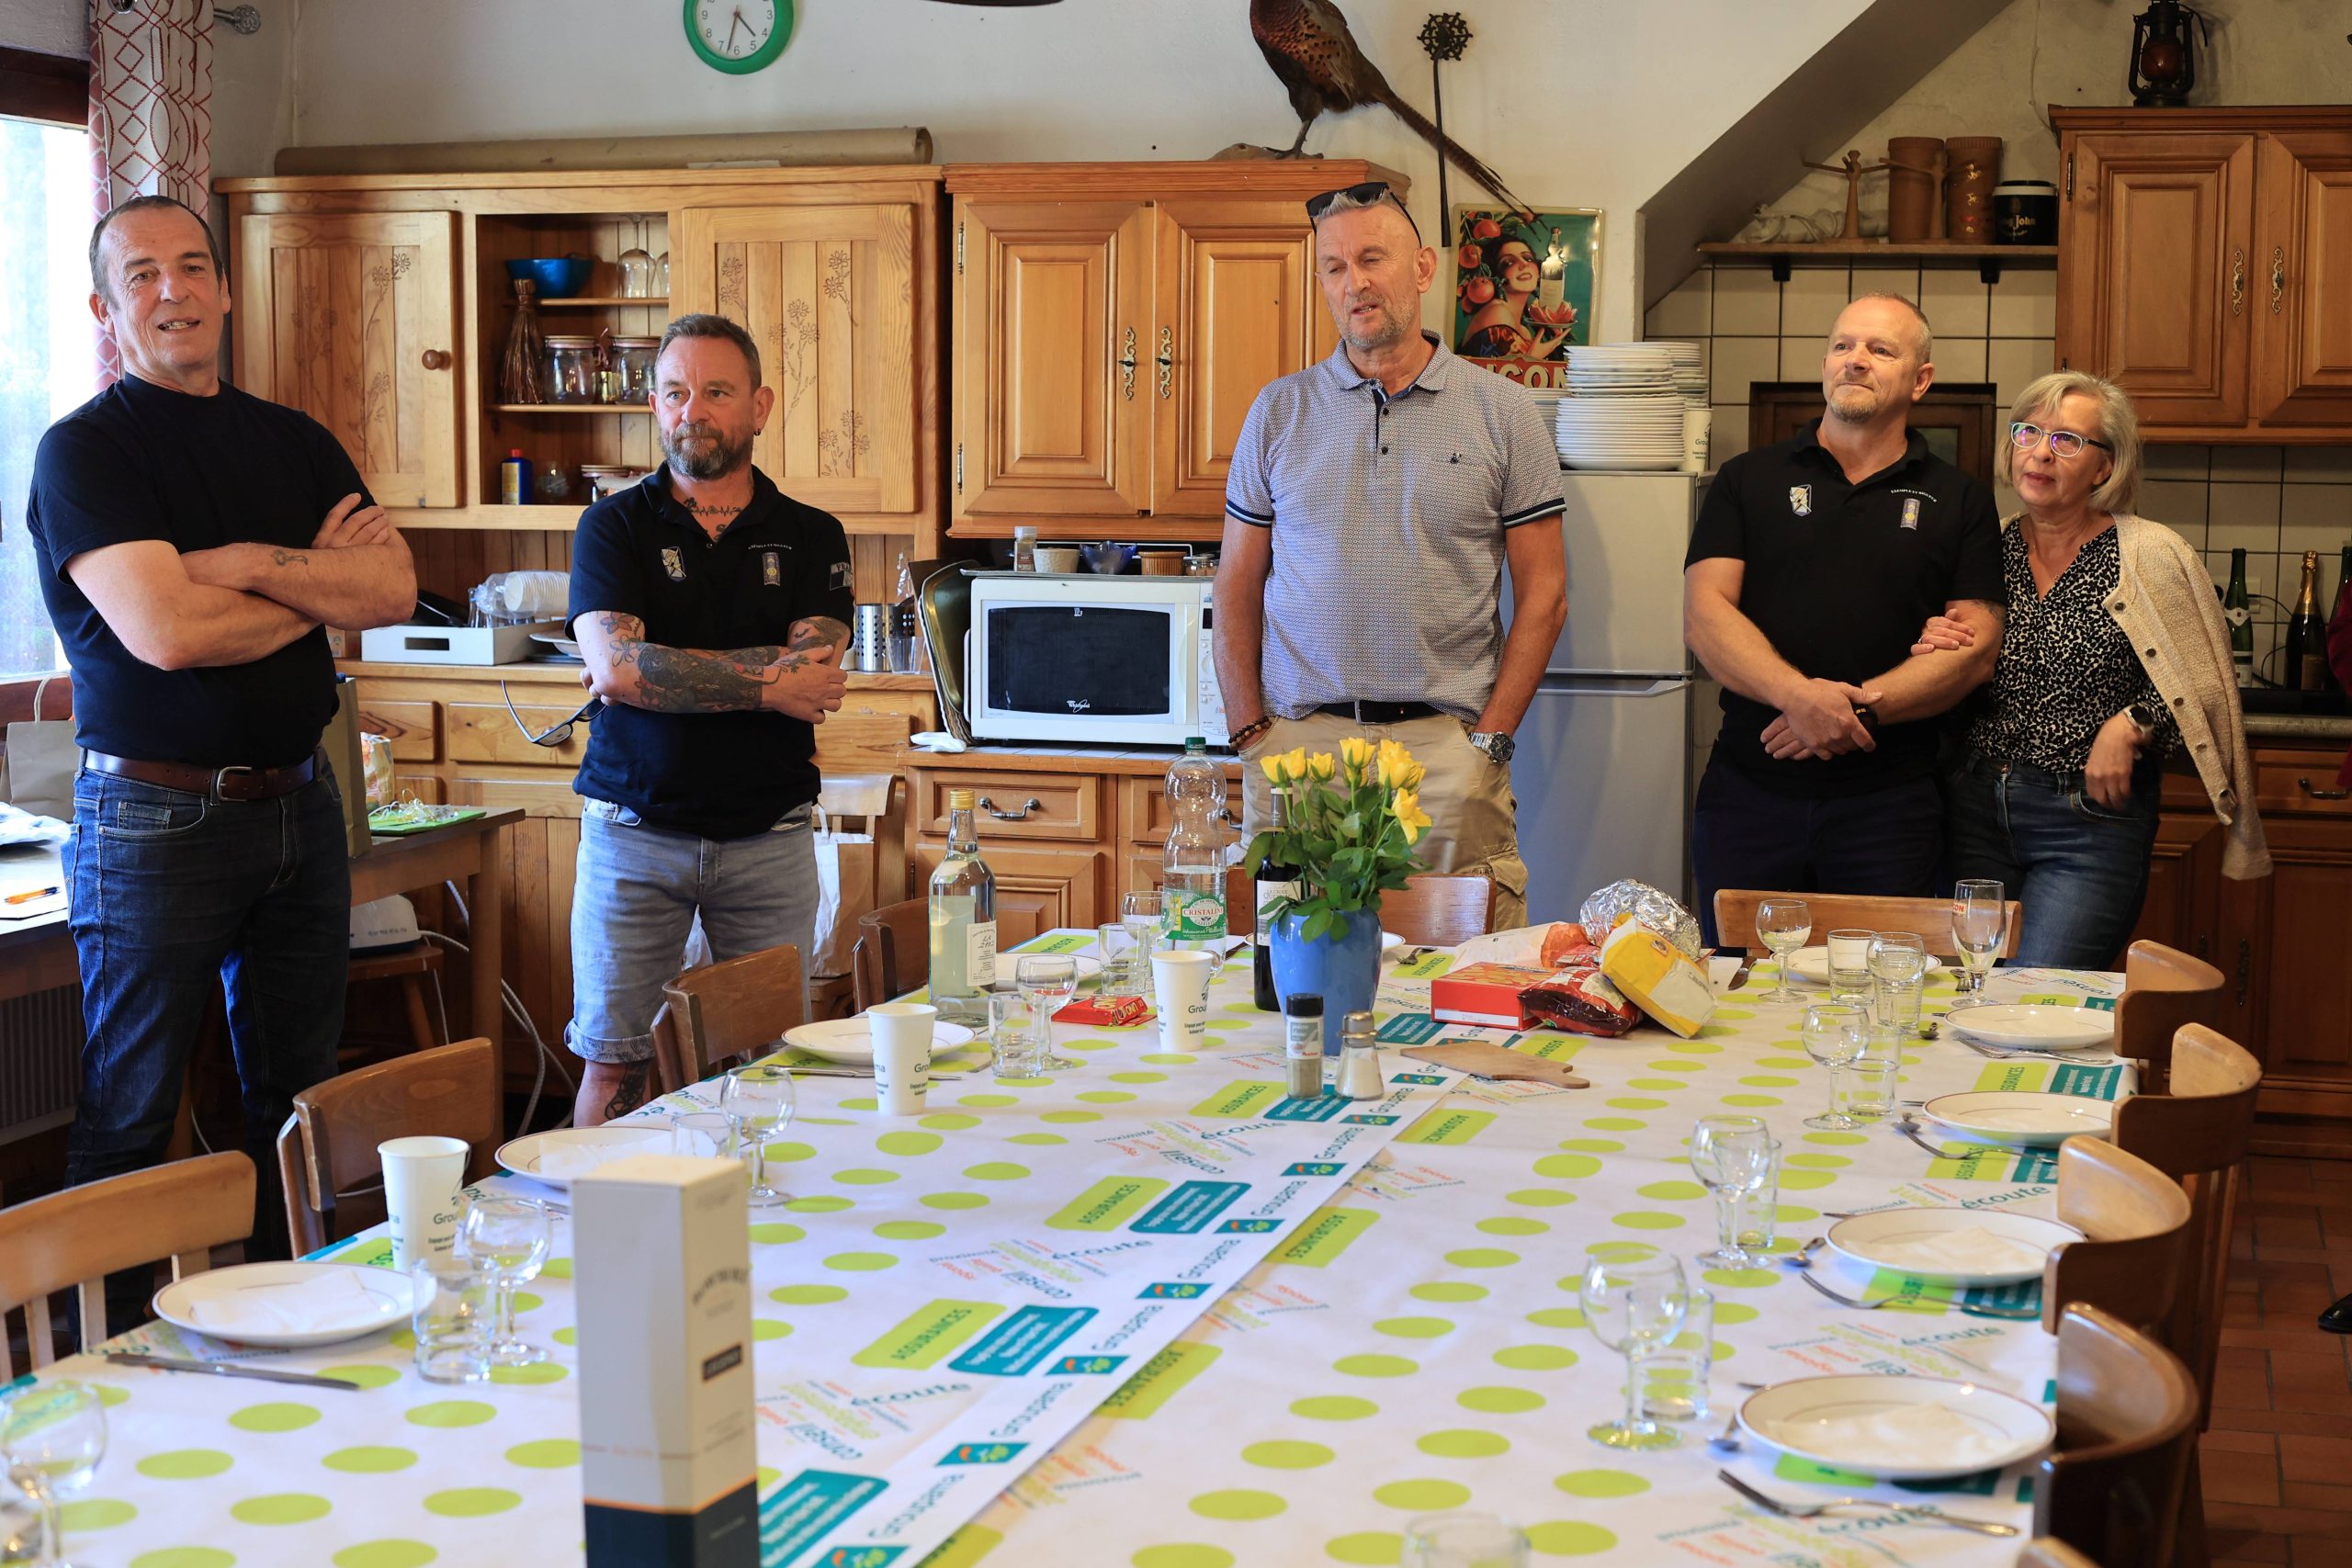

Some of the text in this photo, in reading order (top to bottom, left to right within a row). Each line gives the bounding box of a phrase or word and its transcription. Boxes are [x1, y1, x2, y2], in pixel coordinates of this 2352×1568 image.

[701, 9, 708, 19] 9
[766, 10, 774, 20] 3
[706, 28, 713, 39] 8
[718, 40, 725, 51] 7
[750, 40, 757, 51] 5
[762, 28, 768, 37] 4
[733, 45, 741, 55] 6
[1067, 699, 1091, 710] Whirlpool
[1999, 1066, 2026, 1092] SSURANCES
[1217, 1085, 1268, 1115] ASSURANCES
[1368, 1087, 1416, 1114] Groupama
[1200, 1122, 1288, 1141] écoute
[1314, 1127, 1365, 1160] Groupama
[1159, 1148, 1226, 1176] conseil
[1078, 1183, 1141, 1225] ASSURANCES
[1250, 1180, 1308, 1217] Groupama
[1962, 1185, 2052, 1211] écoute
[1052, 1240, 1153, 1260] écoute
[1177, 1238, 1241, 1280] Groupama
[890, 1308, 972, 1360] ASSURANCES
[1091, 1304, 1164, 1352] Groupama
[1900, 1327, 2006, 1347] écoute
[851, 1382, 972, 1406] écoute
[989, 1381, 1073, 1438] Groupama
[867, 1472, 966, 1539] Groupama
